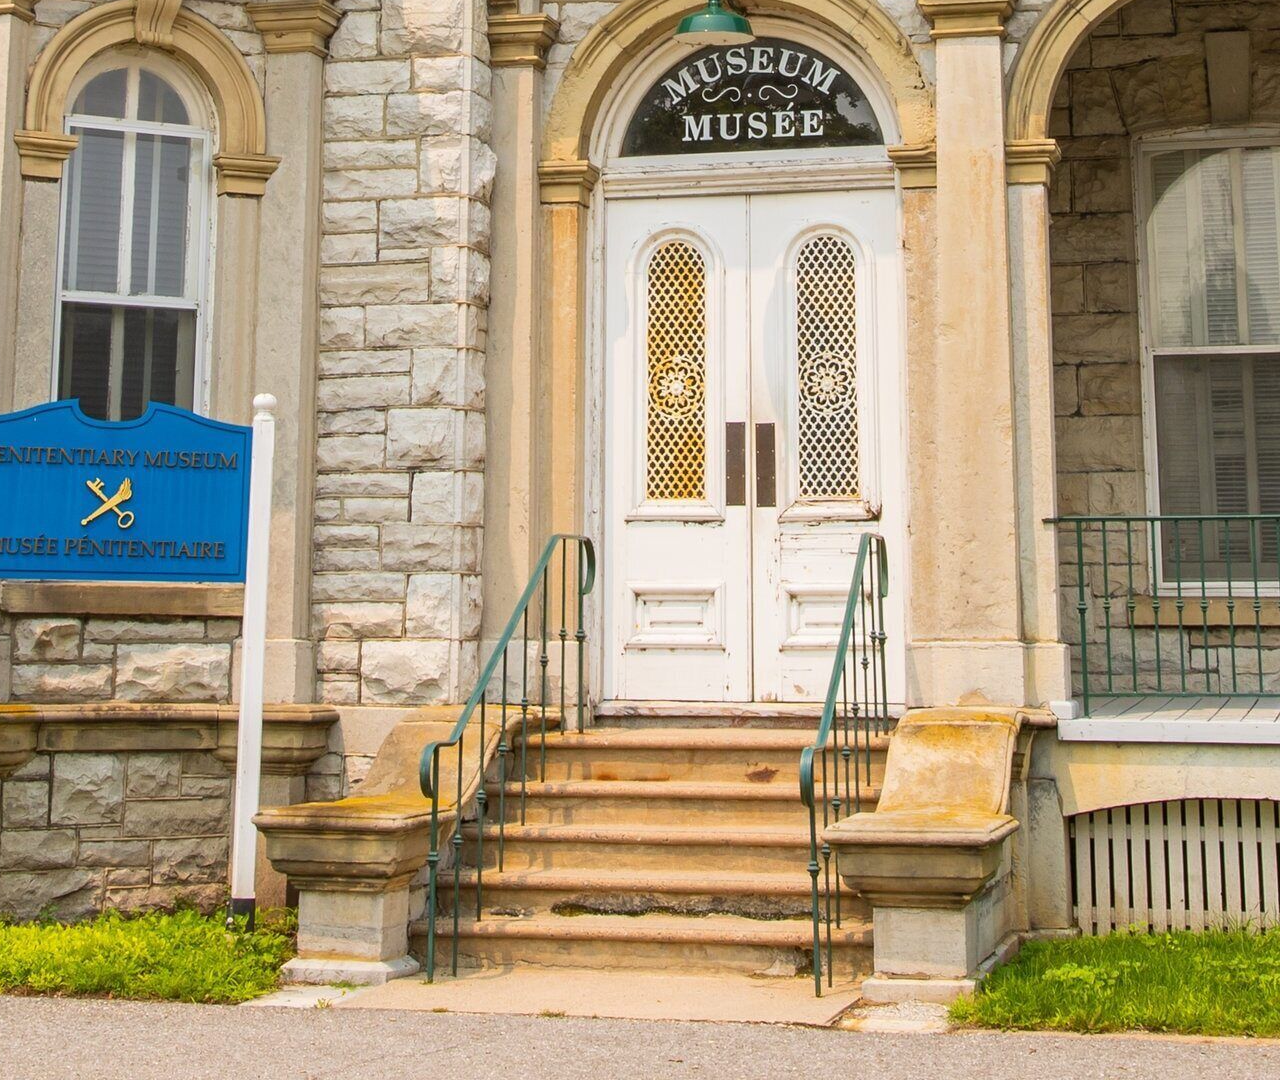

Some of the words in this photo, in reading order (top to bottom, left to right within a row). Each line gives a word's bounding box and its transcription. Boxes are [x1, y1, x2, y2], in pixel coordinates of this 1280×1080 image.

[661, 46, 842, 104] MUSEUM
[682, 102, 824, 142] MUSÉE
[144, 450, 238, 469] MUSEUM
[64, 535, 225, 559] PÉNITENTIAIRE
